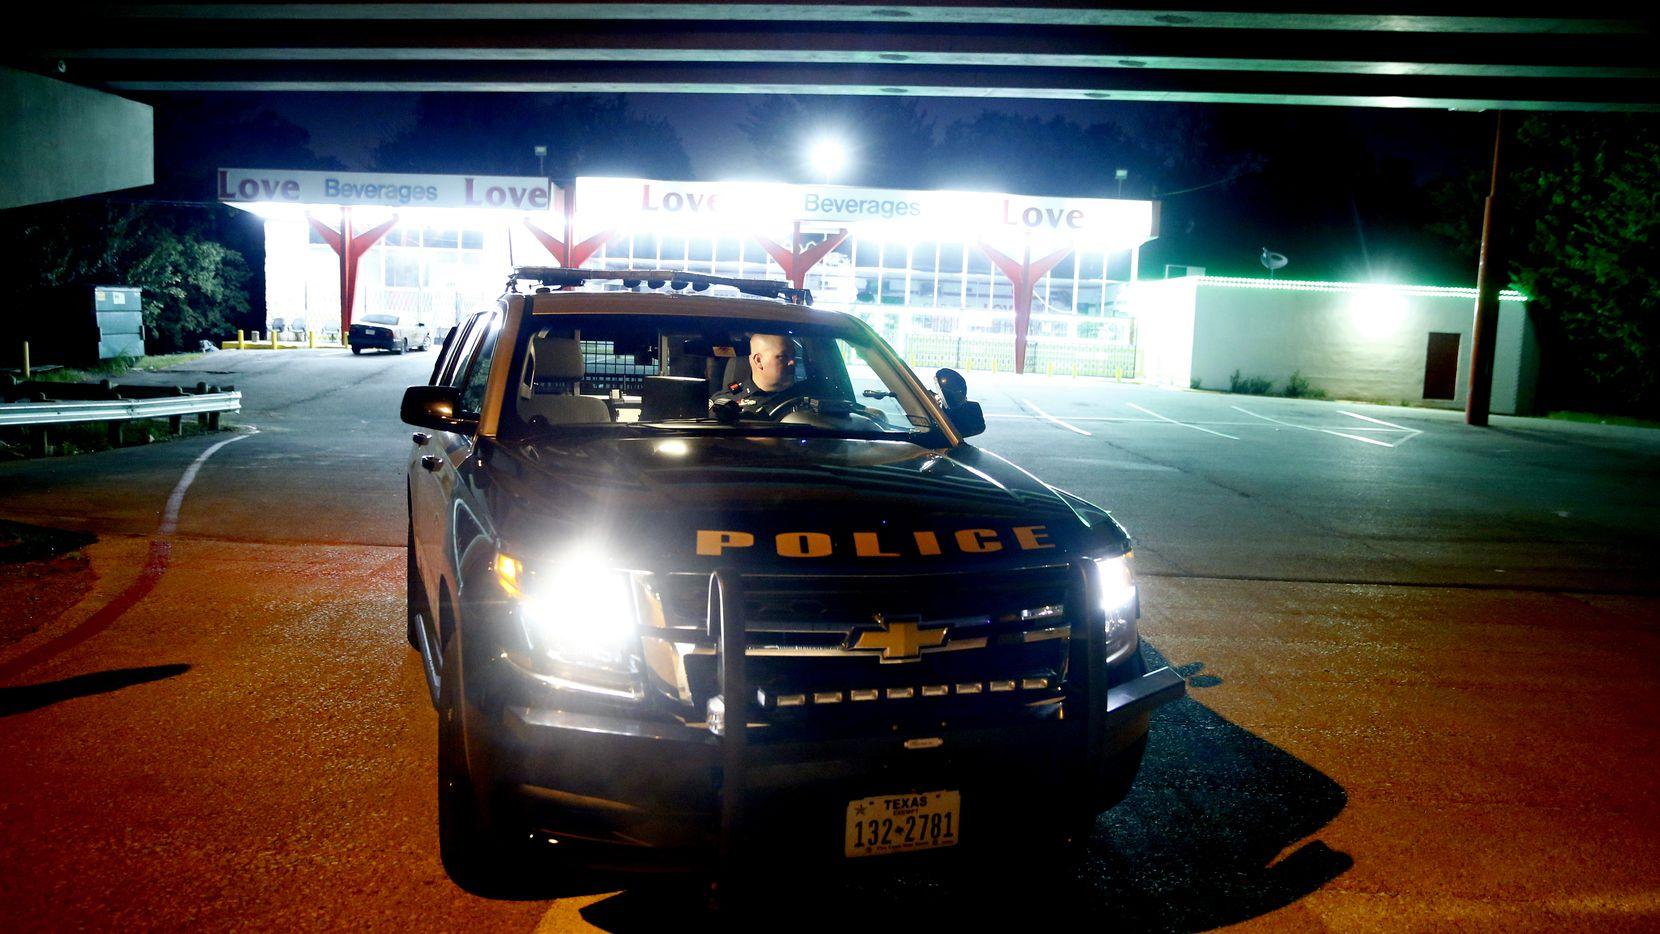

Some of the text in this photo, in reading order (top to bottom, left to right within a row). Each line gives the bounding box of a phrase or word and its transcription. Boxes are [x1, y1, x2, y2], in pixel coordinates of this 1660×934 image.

[218, 170, 548, 209] Love Beverages Love
[642, 184, 1085, 229] Love Beverages Love
[696, 525, 1056, 558] POLICE
[884, 796, 928, 810] TEXAS
